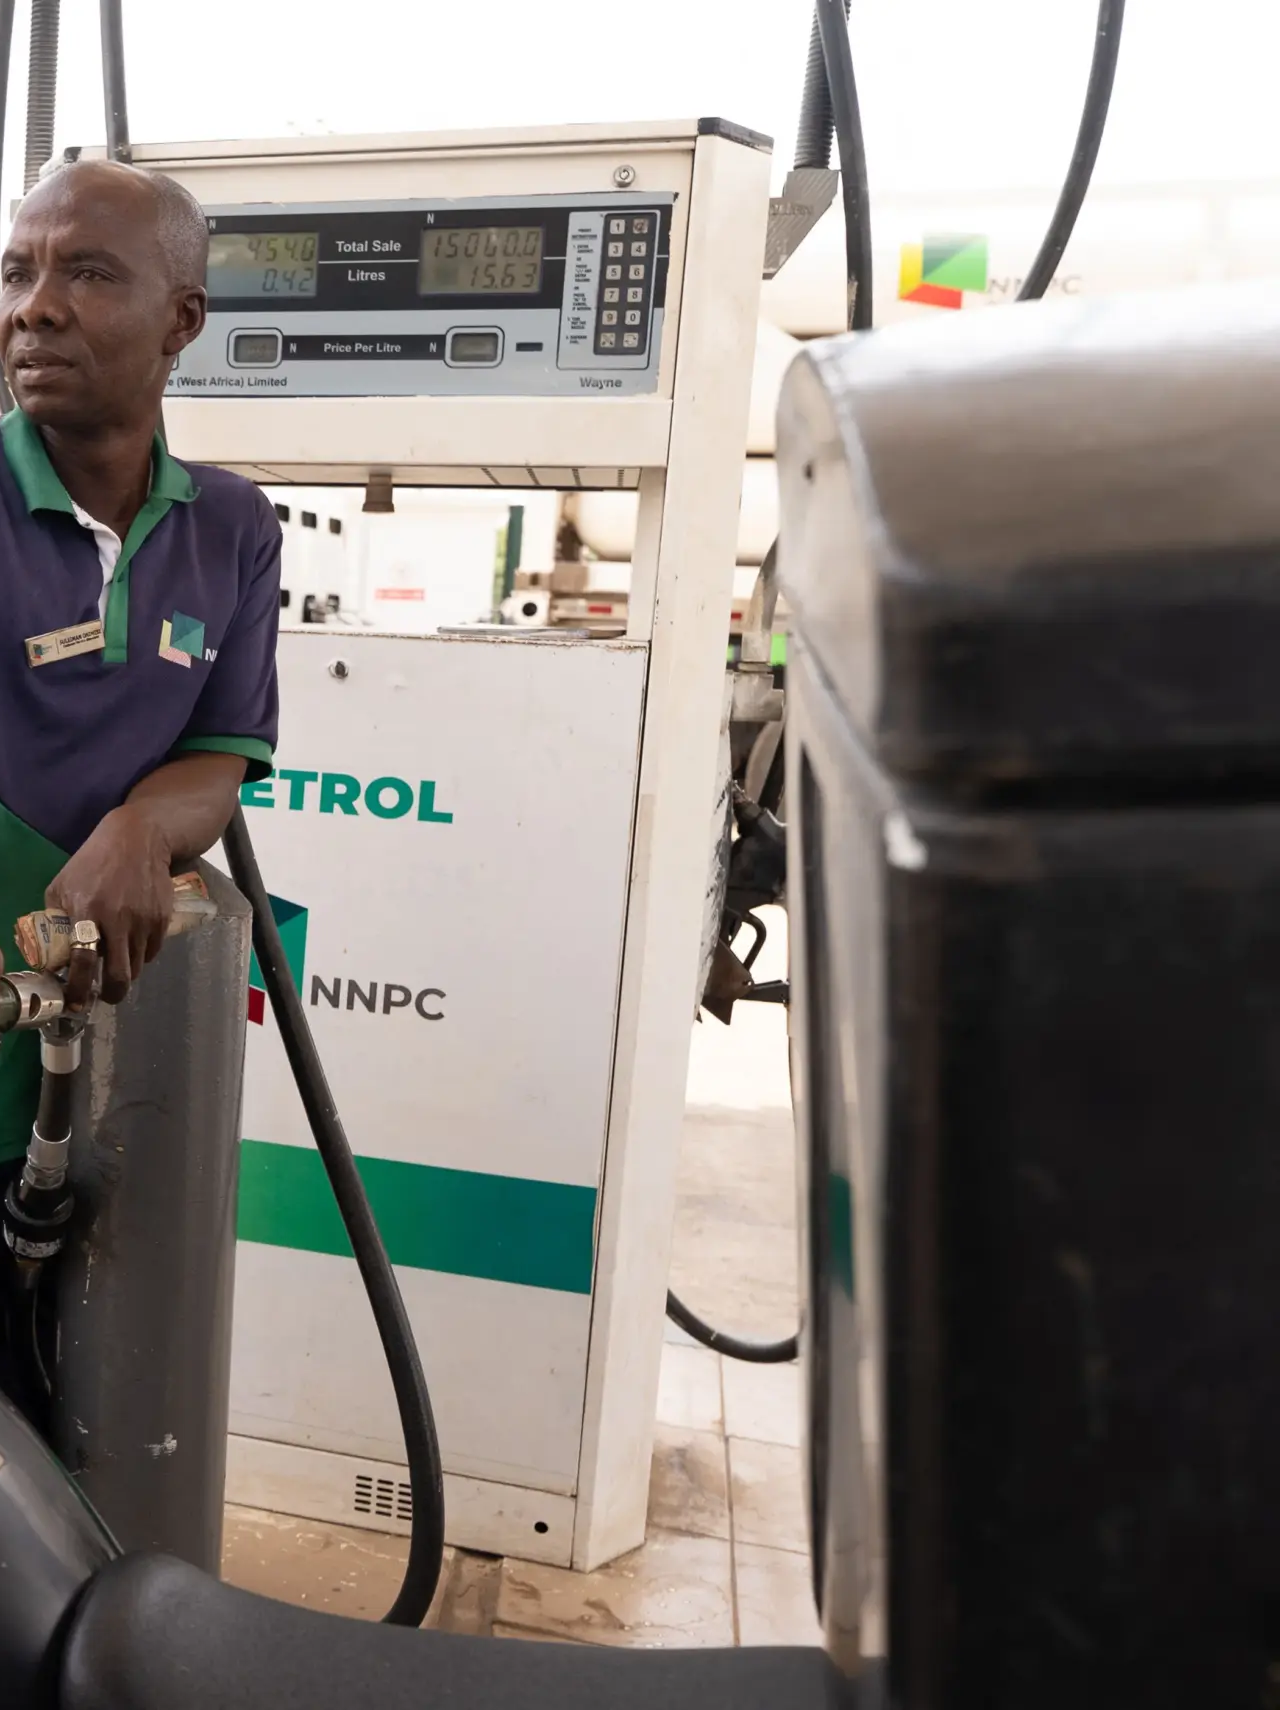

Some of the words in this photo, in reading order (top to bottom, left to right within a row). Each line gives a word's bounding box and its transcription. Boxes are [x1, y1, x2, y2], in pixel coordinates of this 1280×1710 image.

[209, 219, 216, 229] N
[427, 213, 434, 224] N
[336, 240, 368, 252] Total
[372, 239, 401, 252] Sale
[347, 269, 386, 281] Litres
[470, 262, 538, 288] 15.63
[289, 343, 297, 353] N
[323, 343, 352, 353] Price
[354, 343, 372, 353] Per
[376, 342, 401, 353] Litre
[429, 342, 437, 352] N
[177, 376, 206, 388] (West
[209, 376, 244, 388] Africa)
[247, 376, 288, 387] Limited
[580, 376, 622, 390] Wayne
[240, 768, 453, 824] ETROL
[310, 974, 447, 1021] NNPC
